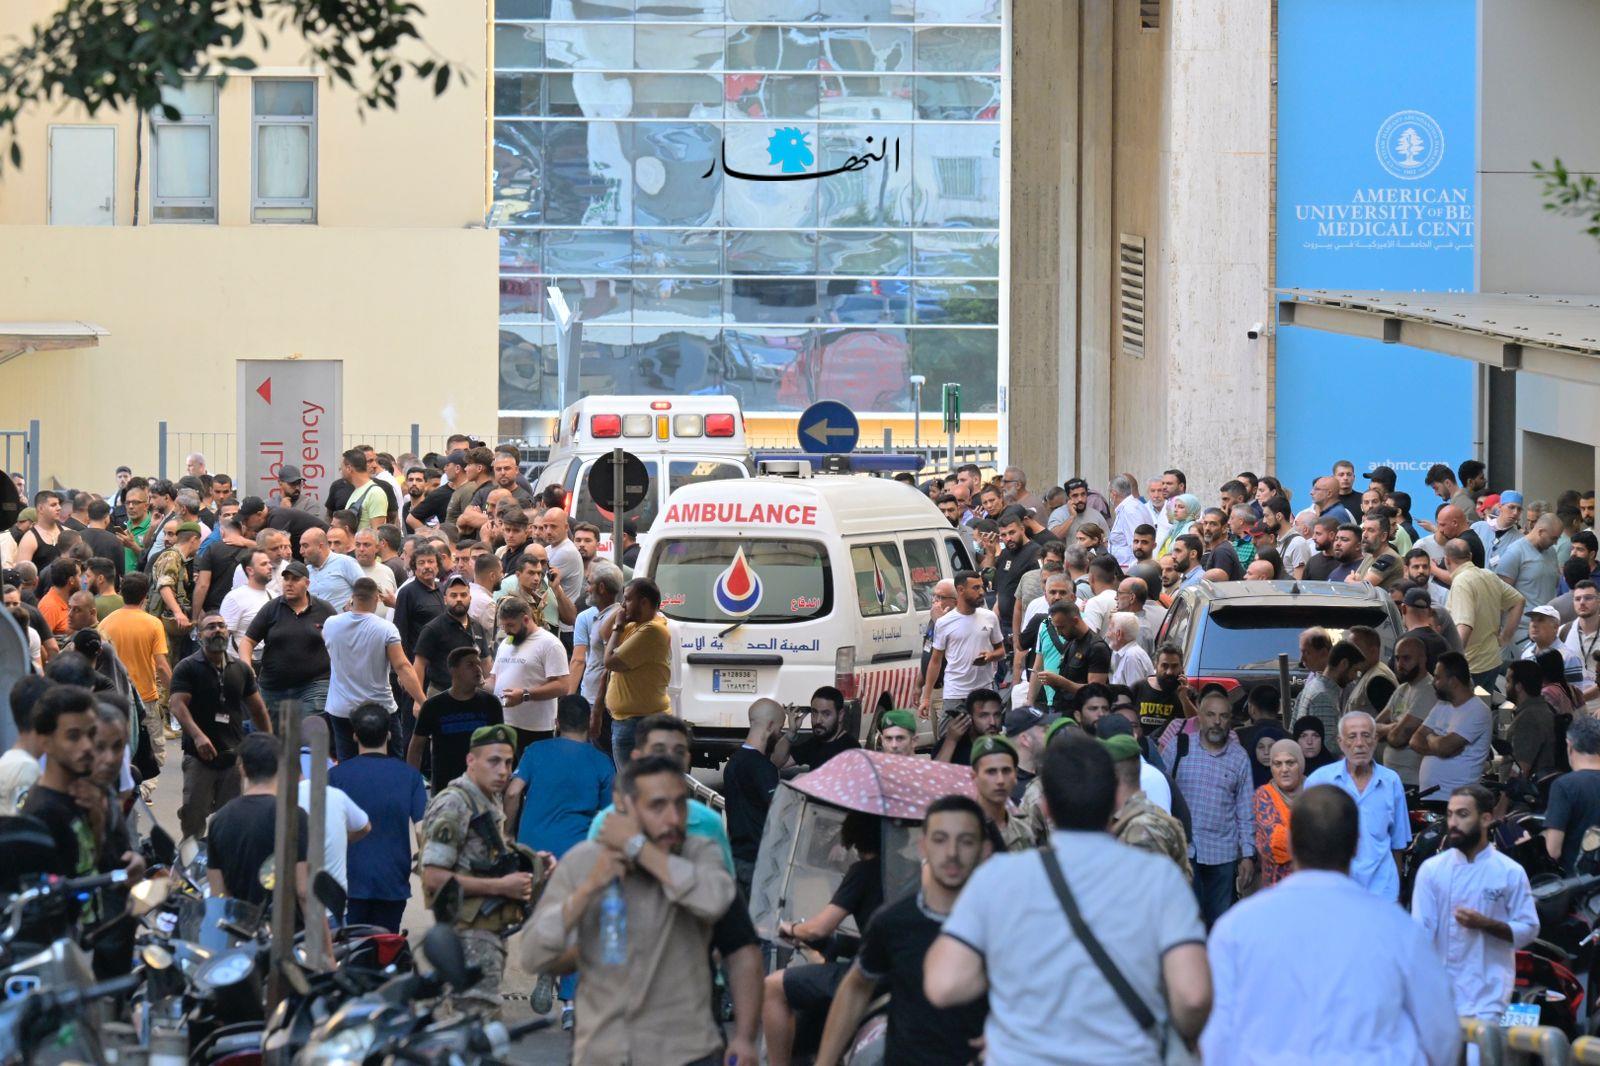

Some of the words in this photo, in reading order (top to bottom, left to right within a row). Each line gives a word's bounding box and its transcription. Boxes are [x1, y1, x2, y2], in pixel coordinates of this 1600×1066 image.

[702, 137, 899, 182] النهار
[1352, 187, 1468, 203] AMERICAN
[1295, 204, 1426, 220] UNIVERSITY
[1427, 207, 1442, 217] OF
[1317, 221, 1413, 237] MEDICAL
[664, 502, 817, 526] AMBULANCE
